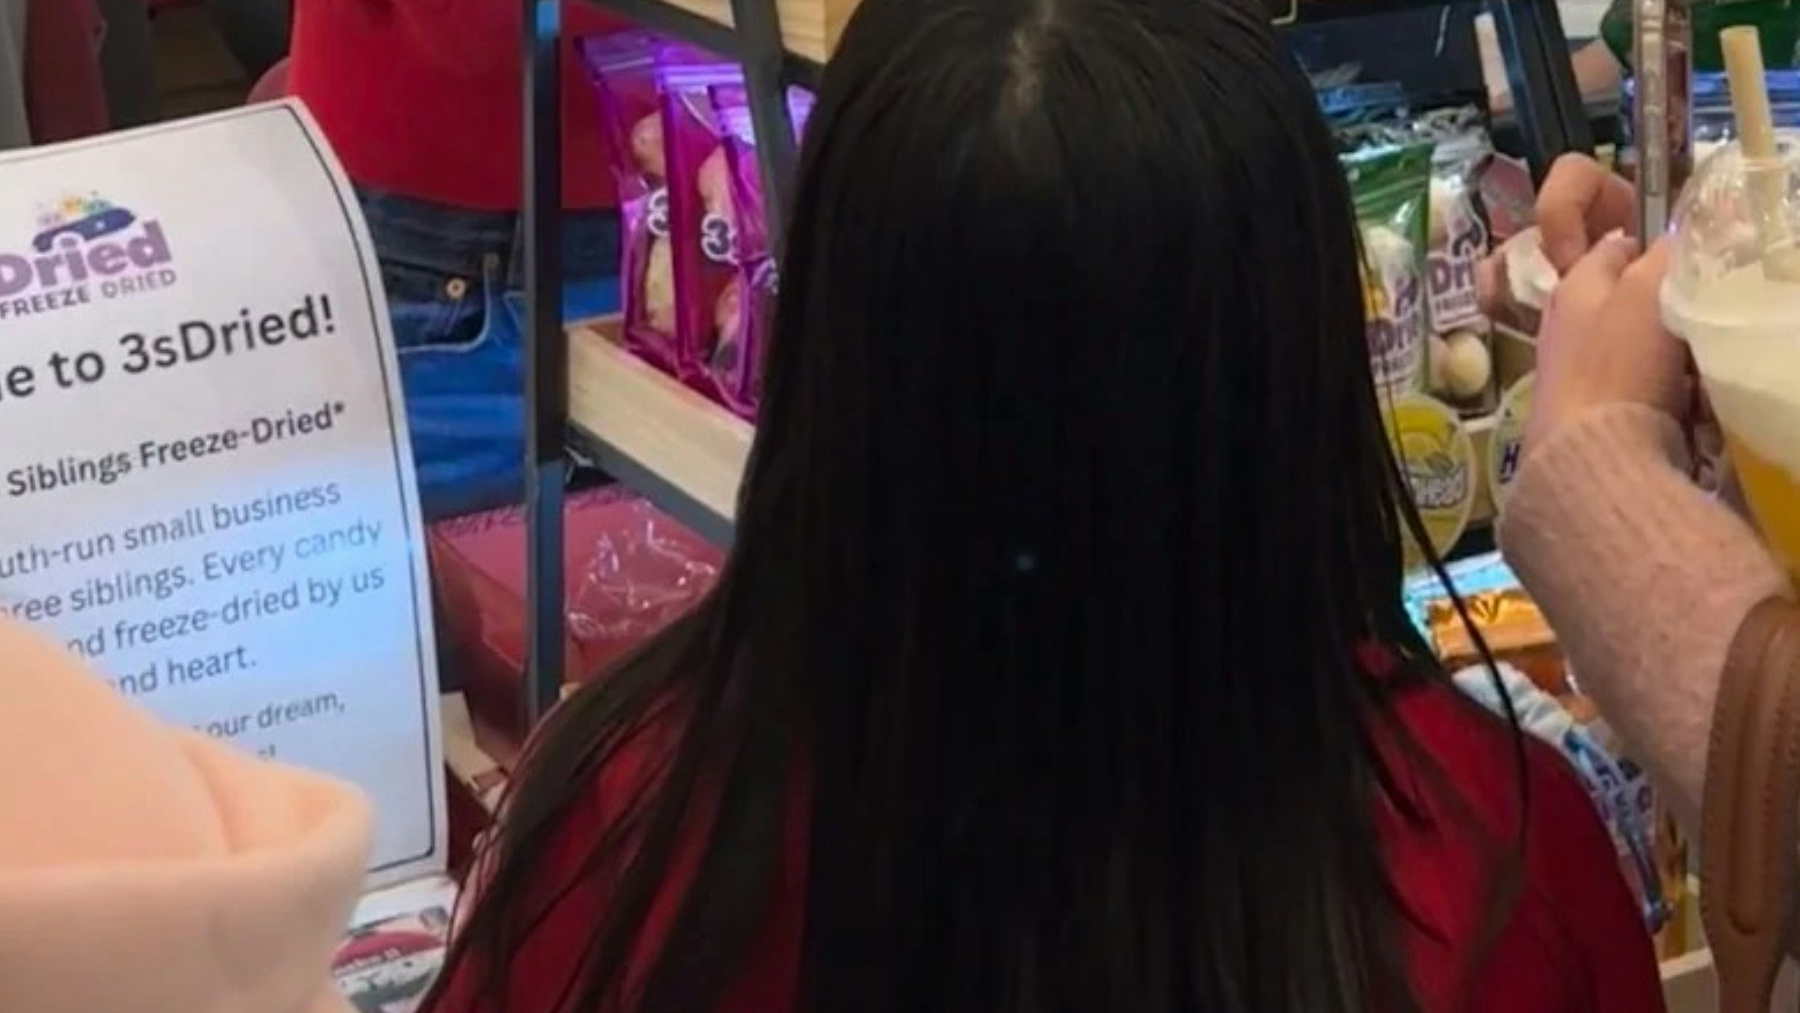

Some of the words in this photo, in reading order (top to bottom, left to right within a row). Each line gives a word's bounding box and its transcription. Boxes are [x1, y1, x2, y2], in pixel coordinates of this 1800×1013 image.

[0, 286, 90, 320] FREEZE
[101, 269, 177, 299] DRIED
[49, 350, 106, 389] to
[119, 293, 335, 375] 3sDried!
[7, 449, 132, 497] Siblings
[124, 506, 206, 552] small
[211, 480, 343, 531] business
[0, 595, 63, 625] ree
[70, 564, 195, 611] siblings.
[203, 541, 286, 583] Every
[293, 517, 384, 561] candy
[67, 630, 107, 660] nd
[114, 584, 301, 651] freeze-dried
[307, 575, 346, 610] by
[351, 566, 386, 594] us
[110, 666, 160, 695] nd
[166, 645, 258, 687] heart.
[256, 690, 347, 731] dream,
